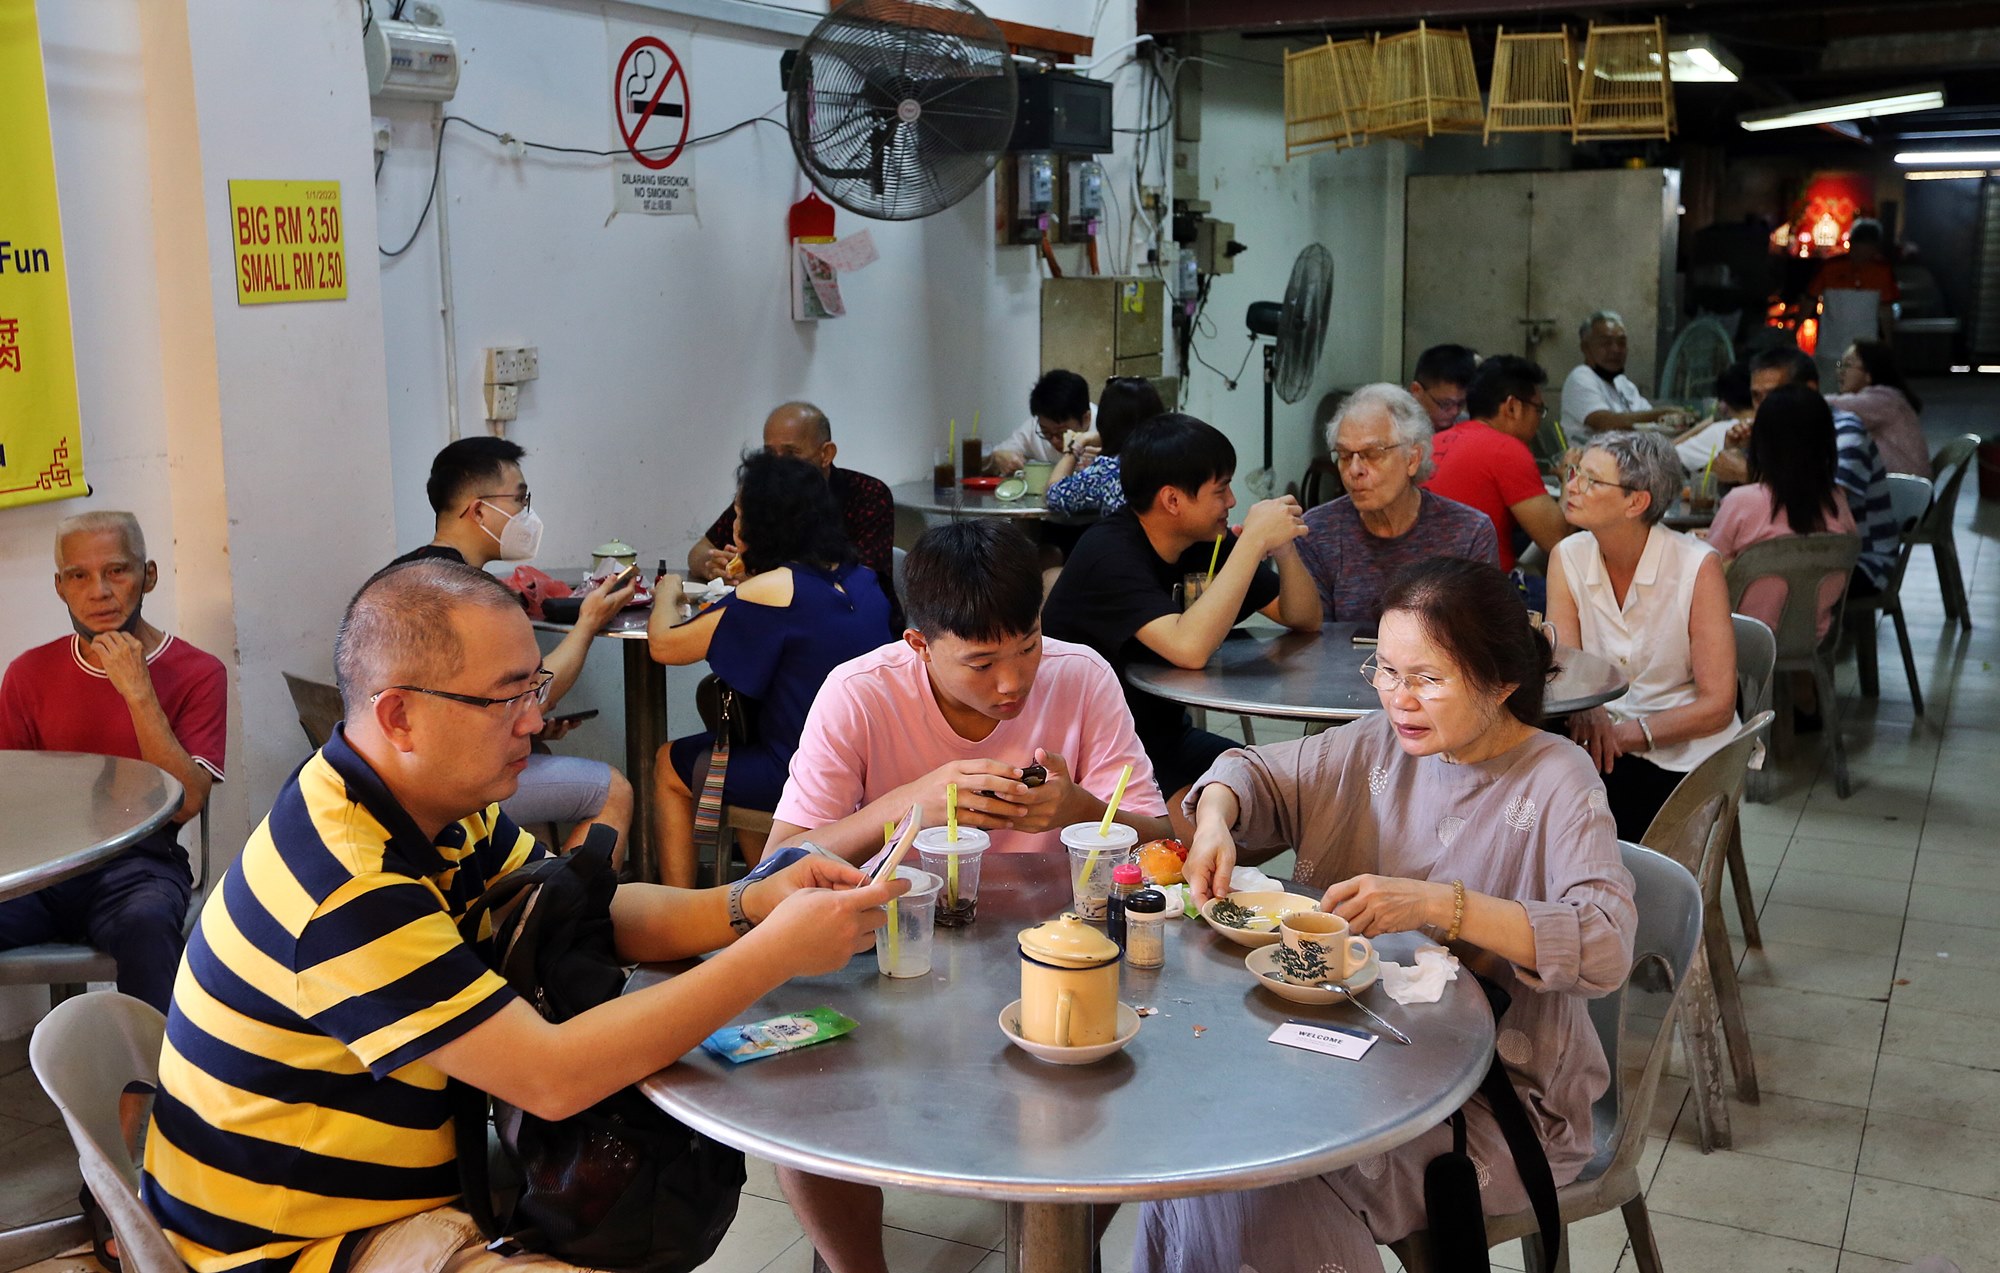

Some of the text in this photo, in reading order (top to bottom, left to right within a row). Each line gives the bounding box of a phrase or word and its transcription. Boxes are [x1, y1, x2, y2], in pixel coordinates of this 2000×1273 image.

[622, 173, 689, 187] DILARANG MEROKOK
[305, 190, 337, 200] 1/1/2023
[634, 187, 679, 199] NO SMOKING
[237, 206, 339, 246] BIG RM 3.50
[0, 241, 50, 274] Fun
[241, 251, 343, 294] SMALL RM 2.50
[1298, 1030, 1344, 1045] WELCOME
